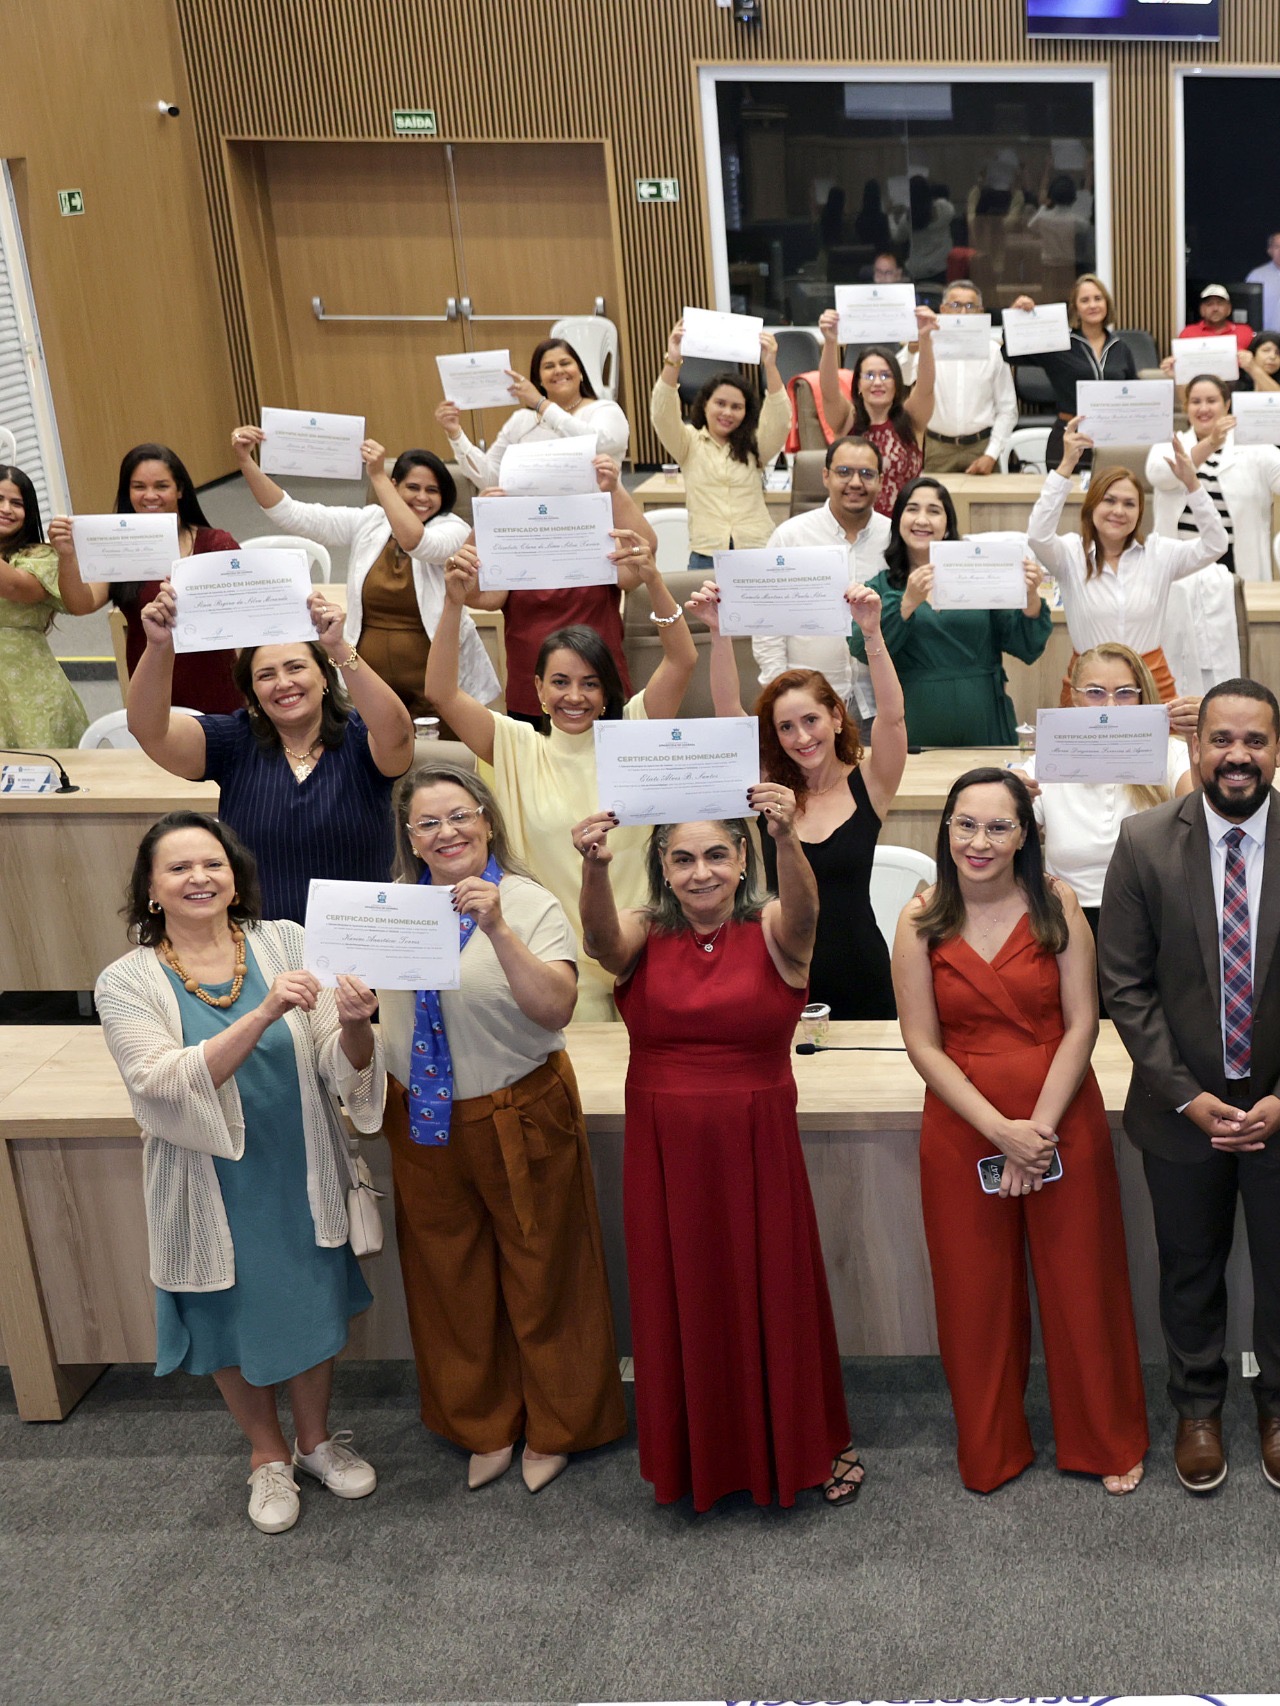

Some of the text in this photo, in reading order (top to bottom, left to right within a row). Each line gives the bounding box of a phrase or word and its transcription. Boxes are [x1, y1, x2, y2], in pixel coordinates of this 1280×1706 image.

[493, 526, 538, 534] CERTIFICADO
[551, 524, 596, 532] HOMENAGEM
[186, 582, 232, 591] CERTIFICADO
[244, 578, 292, 587] HOMENAGEM
[672, 754, 684, 762] EM
[685, 752, 738, 760] HOMENAGEM
[326, 914, 374, 924] CERTIFICADO
[388, 918, 439, 926] HOMENAGEM
